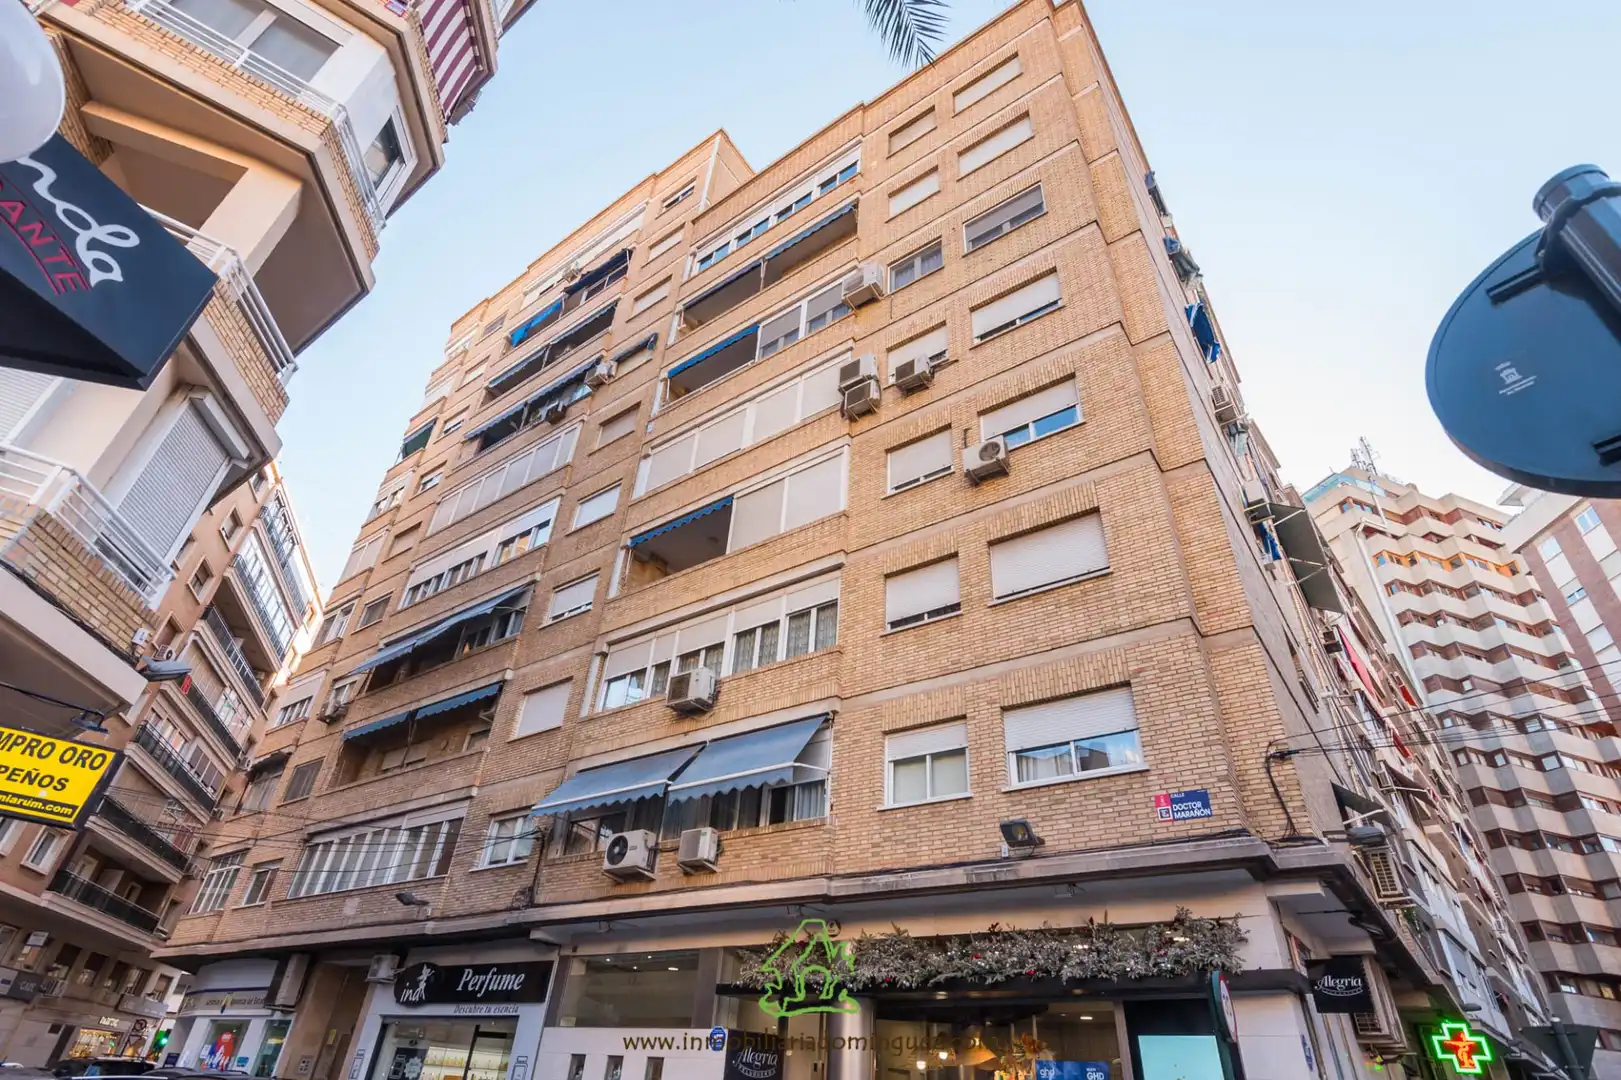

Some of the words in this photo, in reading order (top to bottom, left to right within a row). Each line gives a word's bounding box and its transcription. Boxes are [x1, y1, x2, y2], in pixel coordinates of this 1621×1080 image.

[0, 181, 88, 293] ANTE
[59, 746, 107, 771] ORO
[0, 765, 69, 791] PEÑOS
[1172, 801, 1202, 811] DOCTOR
[456, 967, 525, 997] Perfume
[454, 1004, 483, 1014] Descubre
[493, 1004, 520, 1013] esencia
